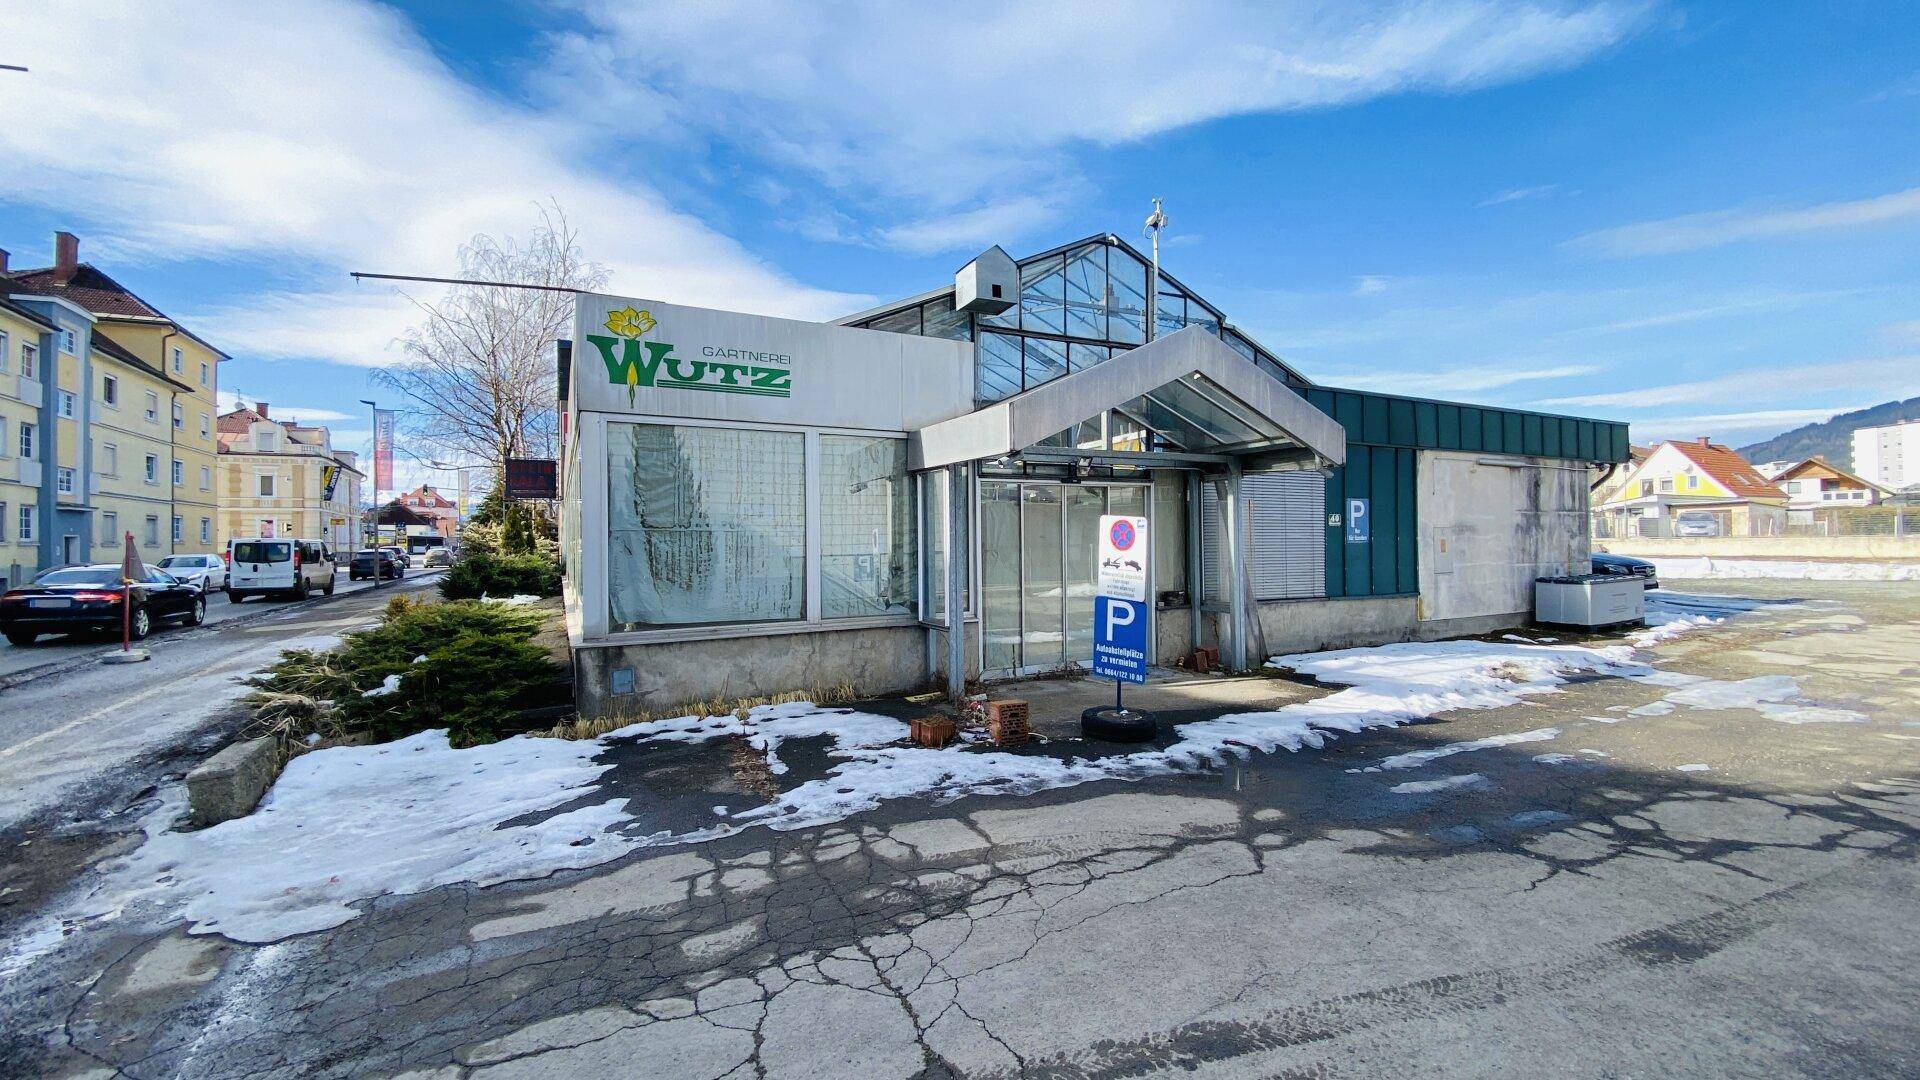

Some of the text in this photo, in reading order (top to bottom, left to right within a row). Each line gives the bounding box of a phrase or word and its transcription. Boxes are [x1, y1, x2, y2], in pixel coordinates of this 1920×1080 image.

[702, 345, 791, 365] GÄRTNEREI
[1351, 500, 1365, 528] P
[1106, 598, 1136, 641] P
[1096, 643, 1144, 660] Autoabstellplätze
[1101, 655, 1138, 669] zu vermieten
